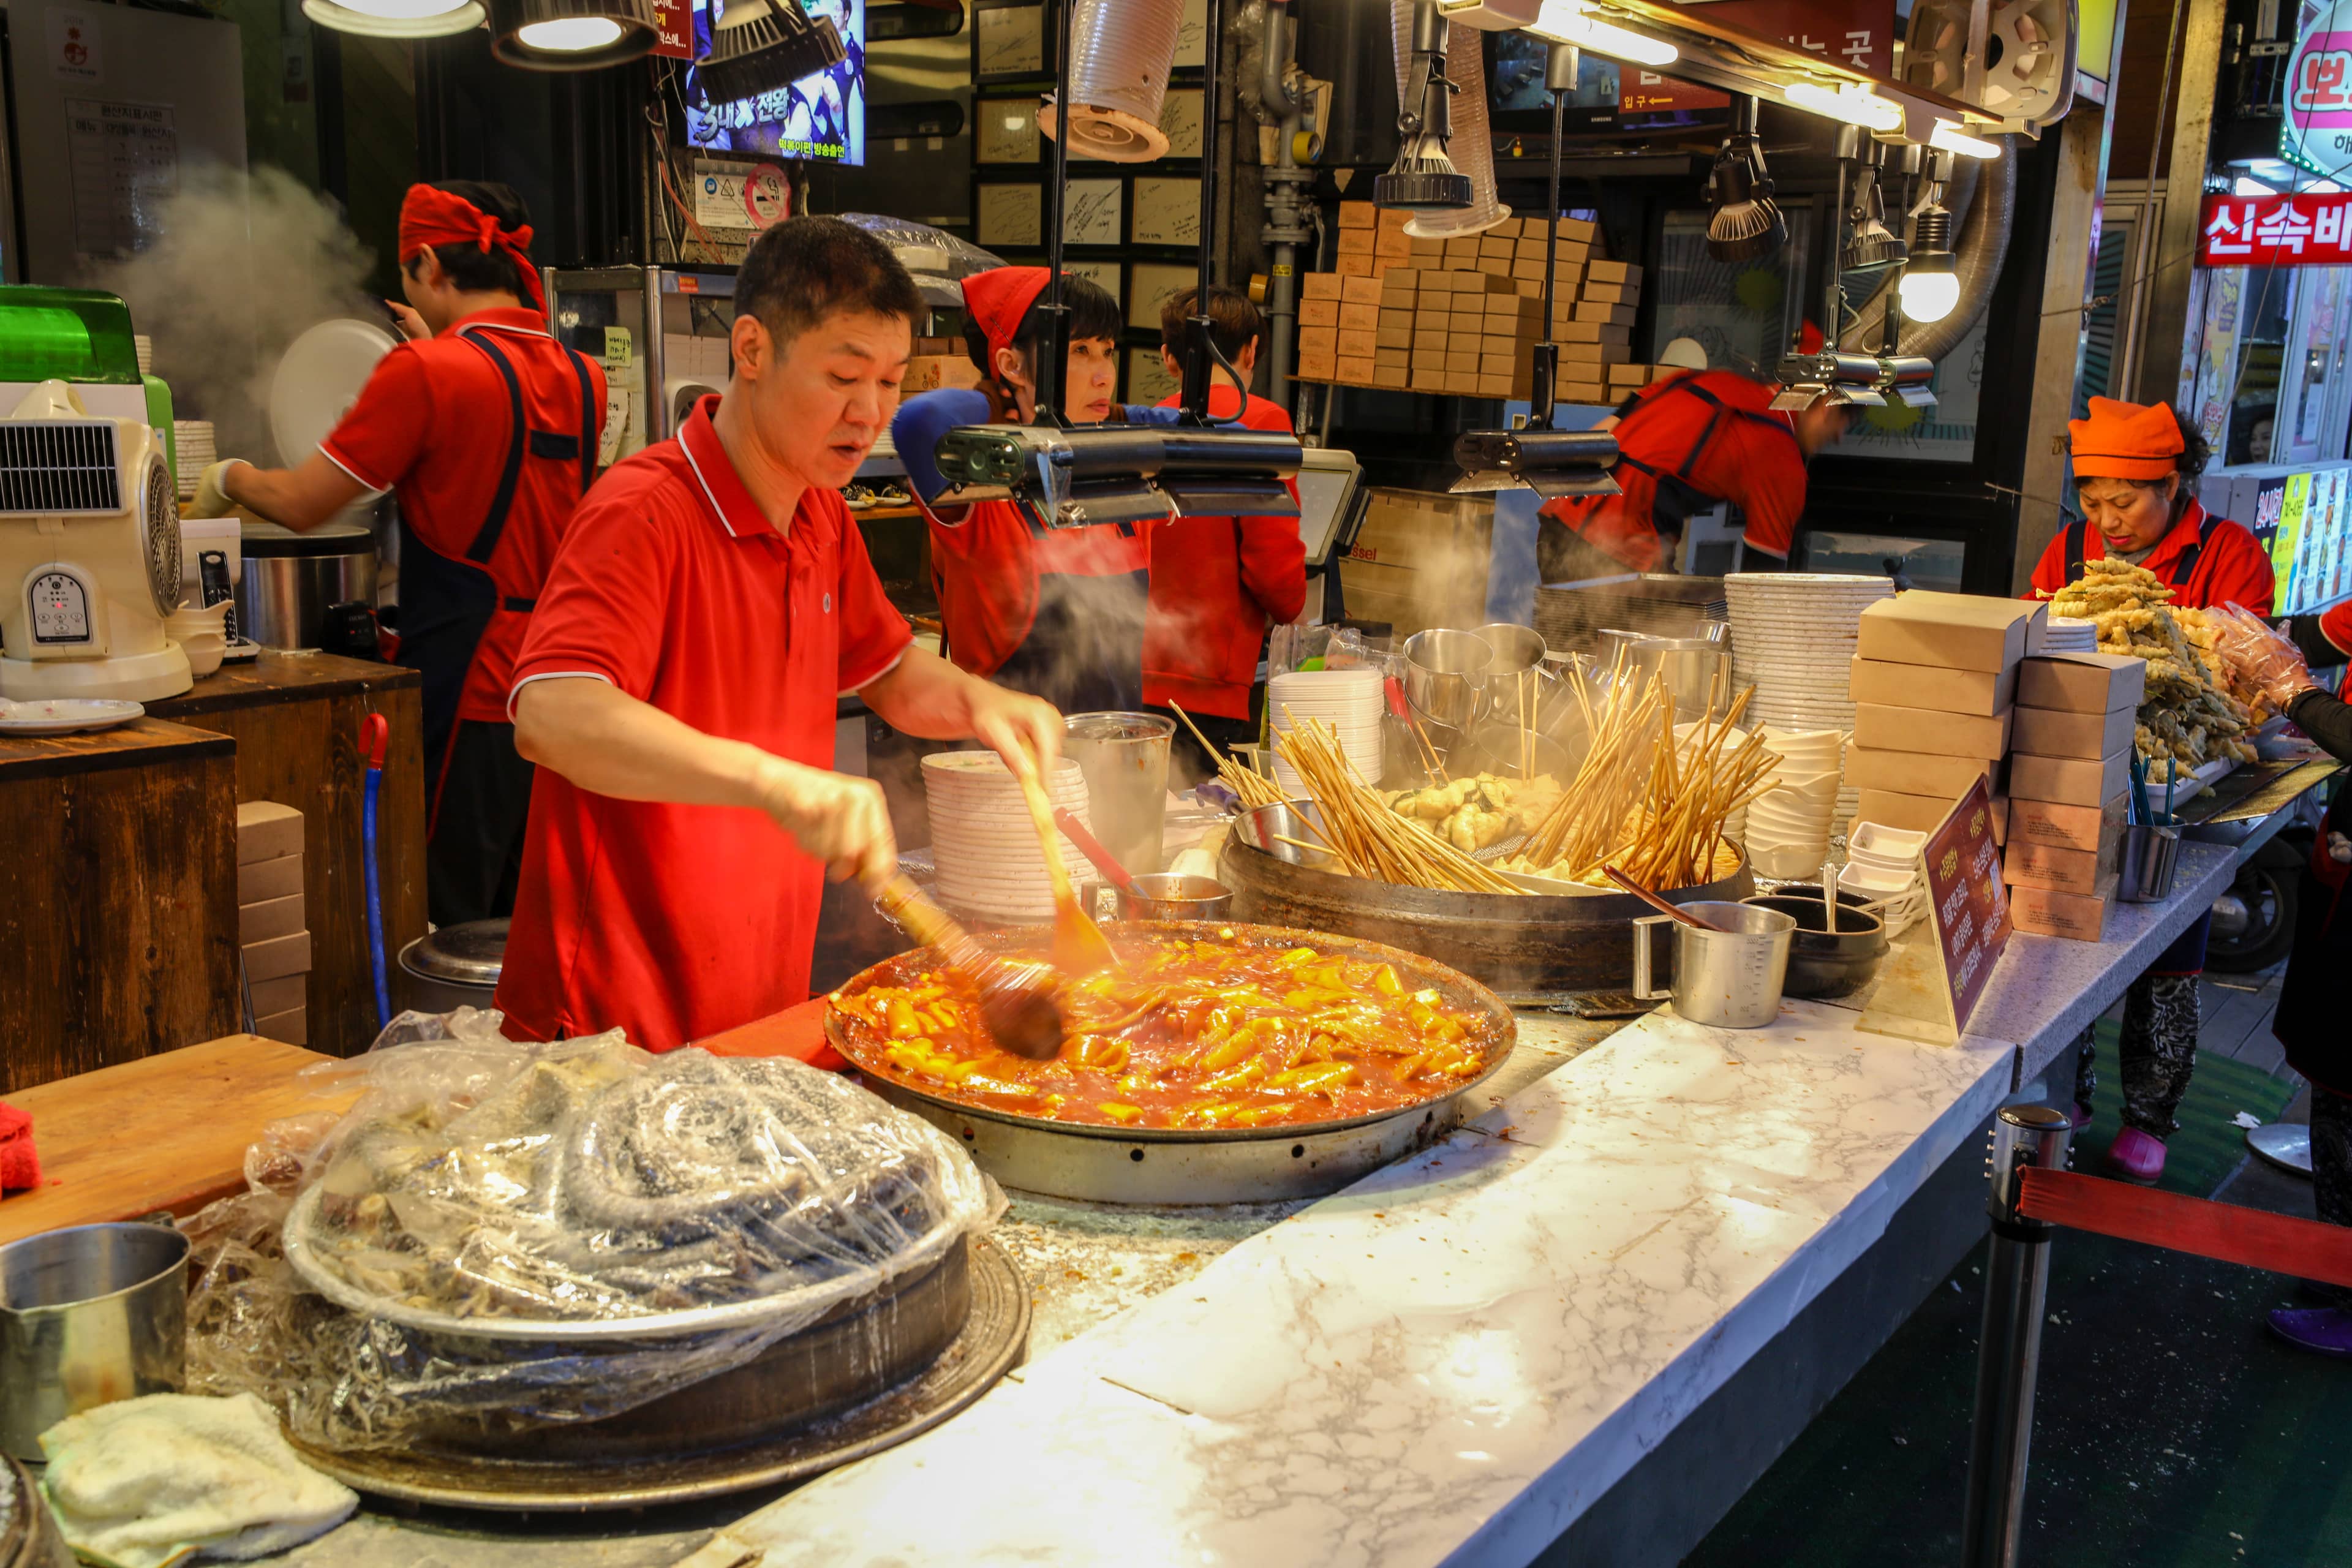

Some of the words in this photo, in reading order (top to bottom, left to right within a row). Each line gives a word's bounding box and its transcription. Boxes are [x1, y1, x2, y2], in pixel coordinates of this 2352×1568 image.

[1624, 95, 1646, 109] 입구
[778, 138, 811, 154] 떡볶이편
[1349, 546, 1378, 561] ssel
[1940, 845, 1956, 884] 주문방법
